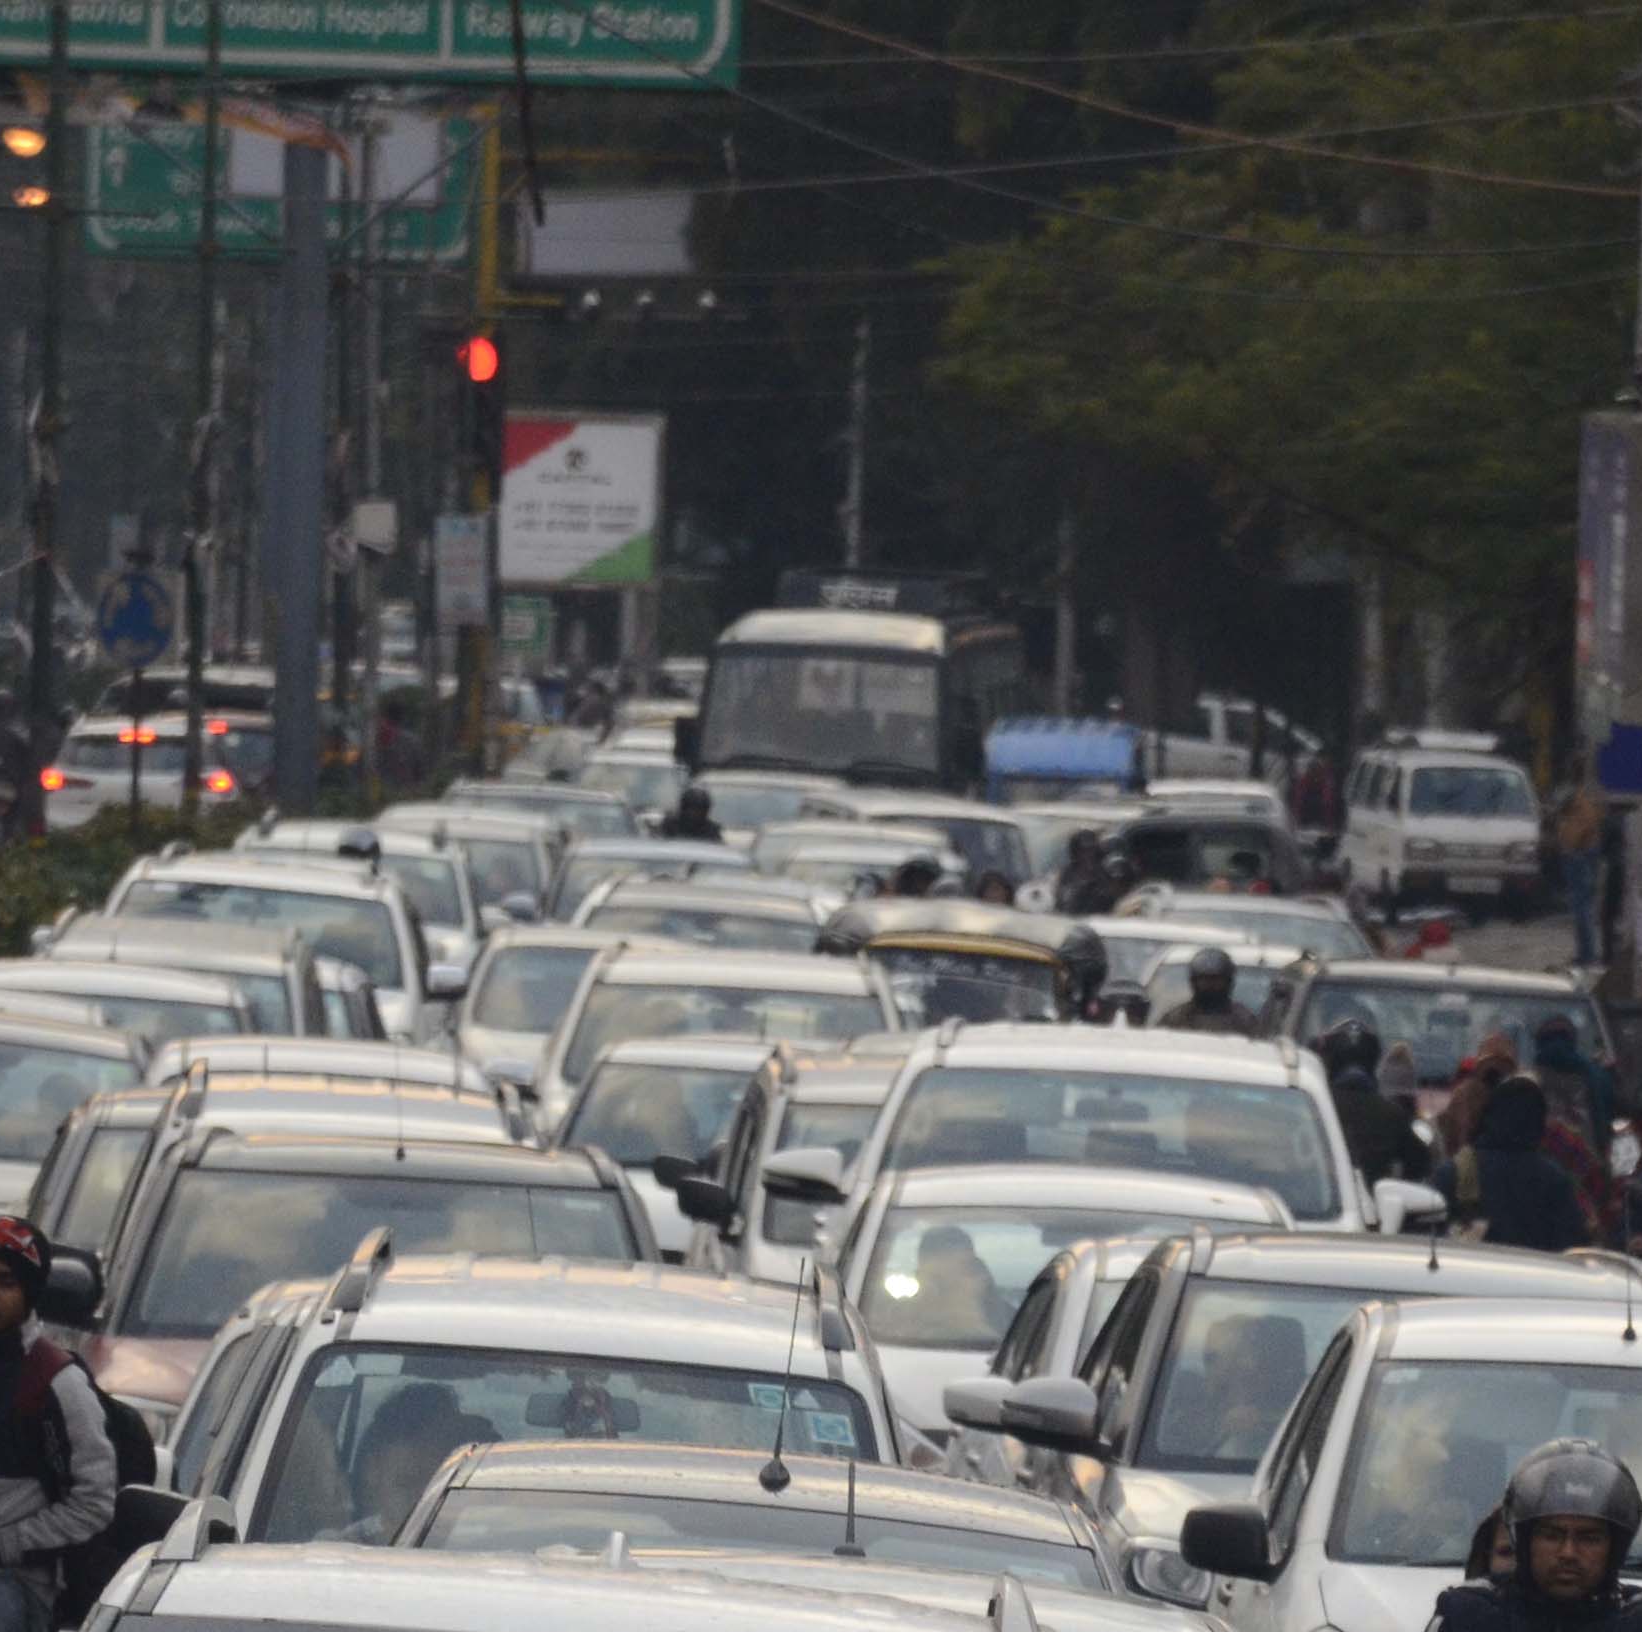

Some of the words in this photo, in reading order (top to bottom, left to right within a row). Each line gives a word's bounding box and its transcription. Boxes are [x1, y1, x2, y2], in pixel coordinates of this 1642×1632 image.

[171, 0, 318, 32] Coonation
[324, 2, 428, 43] Hospital
[465, 4, 586, 48] Raway
[591, 5, 700, 42] Station
